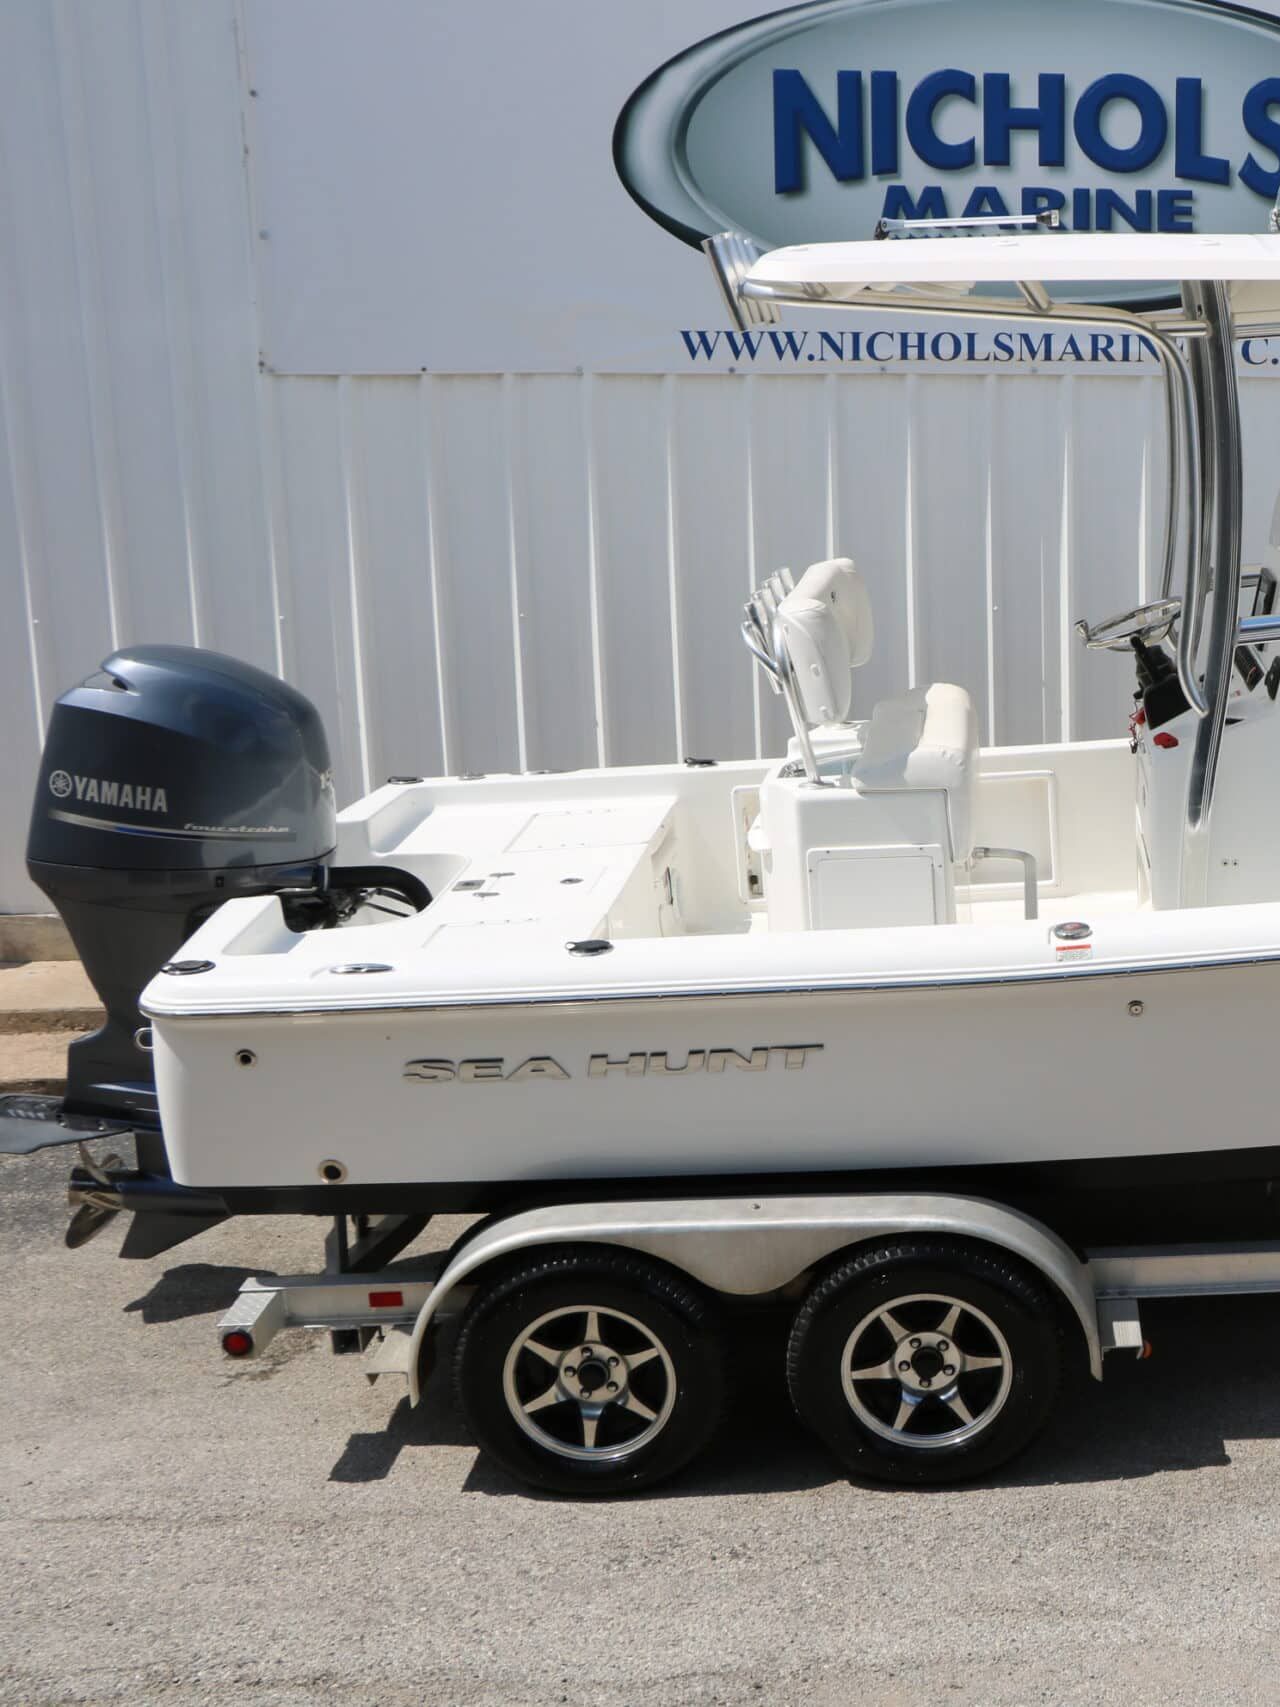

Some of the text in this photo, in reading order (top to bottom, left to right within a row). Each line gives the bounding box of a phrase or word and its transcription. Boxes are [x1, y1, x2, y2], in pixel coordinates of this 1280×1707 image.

[880, 184, 1194, 233] MARINE
[74, 775, 168, 812] YAMAHA
[402, 1043, 825, 1084] SEA HUNT
